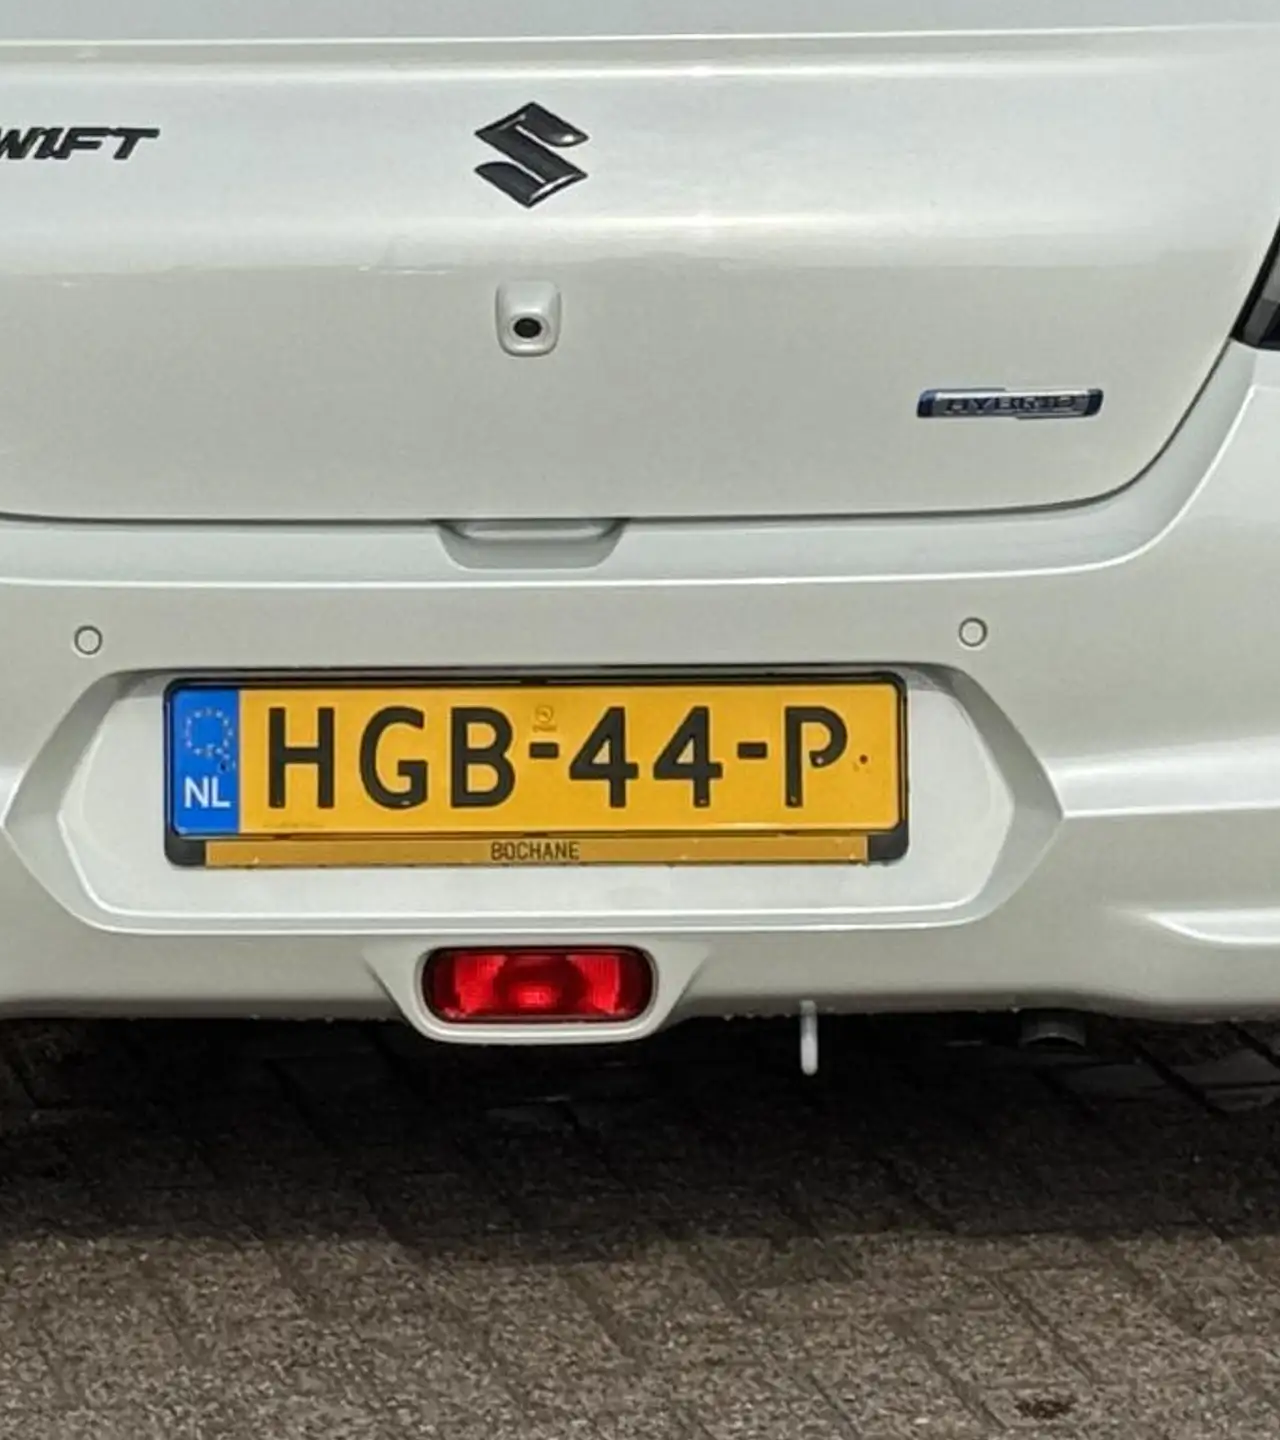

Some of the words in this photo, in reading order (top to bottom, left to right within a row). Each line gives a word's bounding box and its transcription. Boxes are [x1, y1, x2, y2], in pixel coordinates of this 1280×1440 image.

[267, 705, 849, 811] HGB-44-P
[184, 776, 231, 809] NL
[490, 841, 580, 861] BOCHANE
